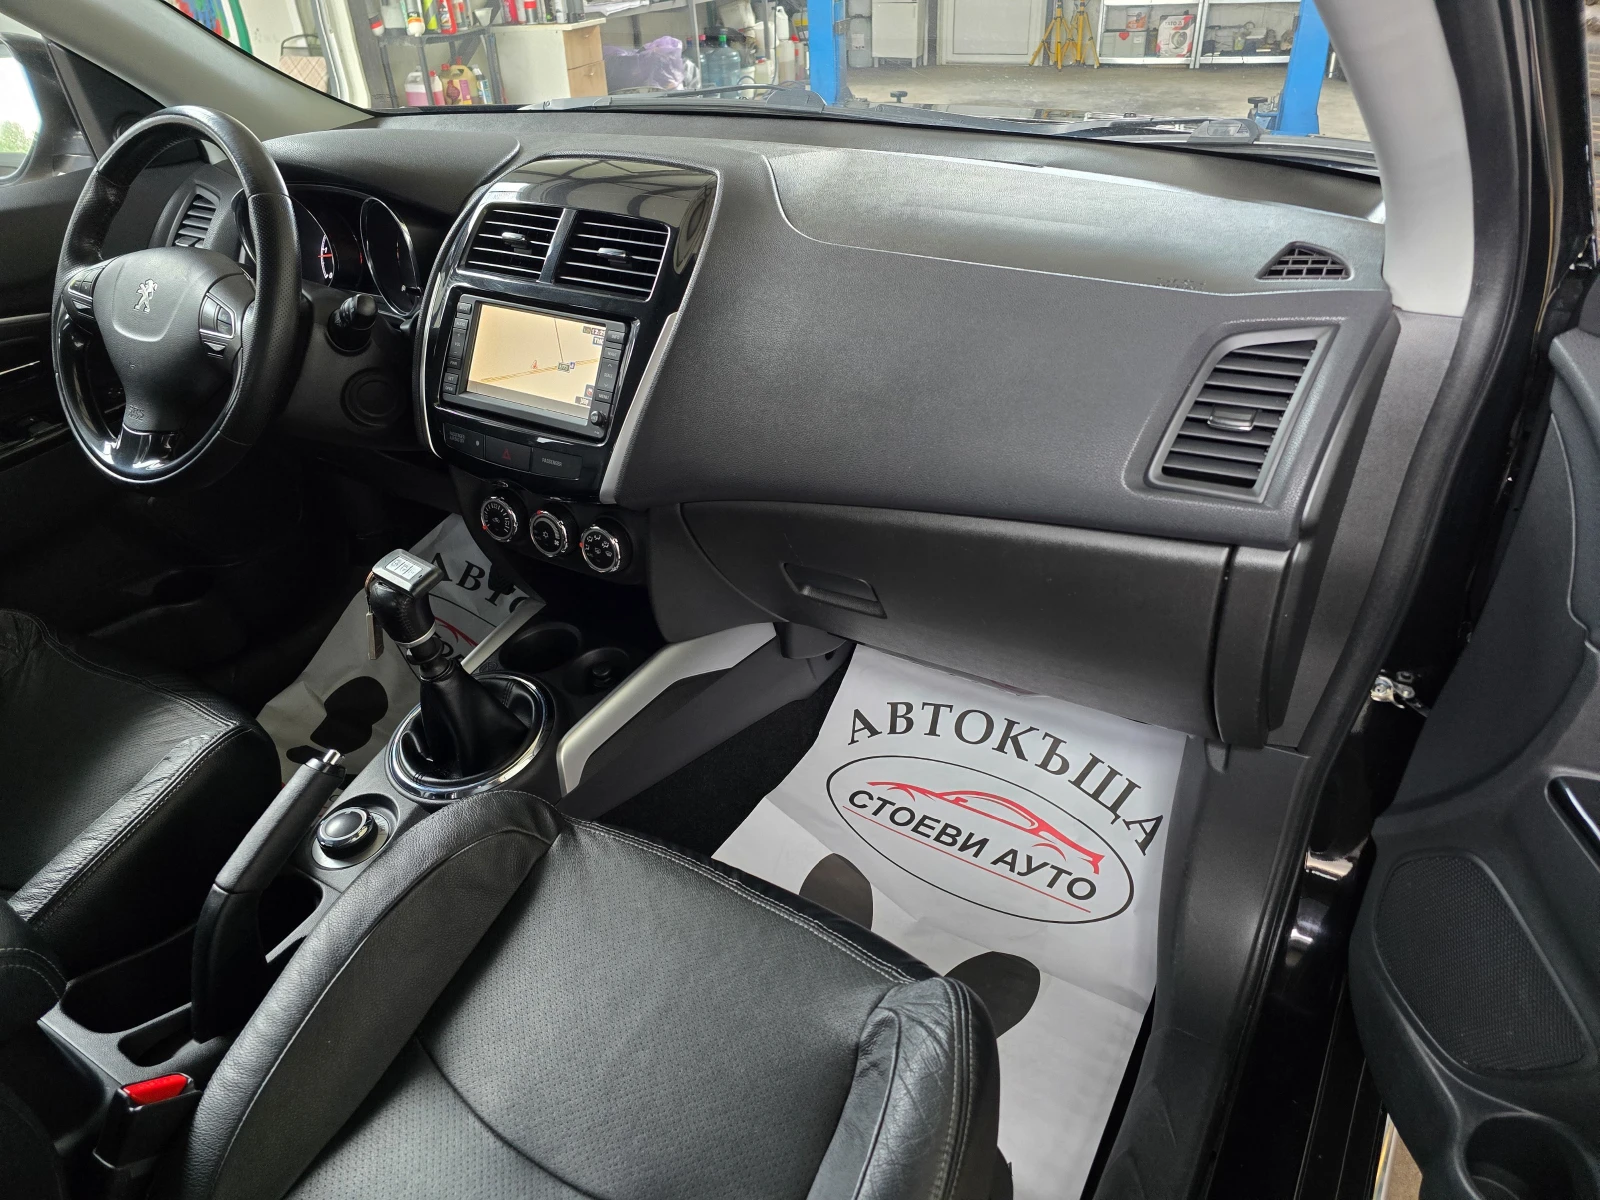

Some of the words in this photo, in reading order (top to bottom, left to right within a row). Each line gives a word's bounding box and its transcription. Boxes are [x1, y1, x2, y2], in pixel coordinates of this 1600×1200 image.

[847, 701, 1164, 856] АВТОКЪЩА
[848, 789, 990, 858] СТОЕВИ
[990, 848, 1097, 901] АУТО
